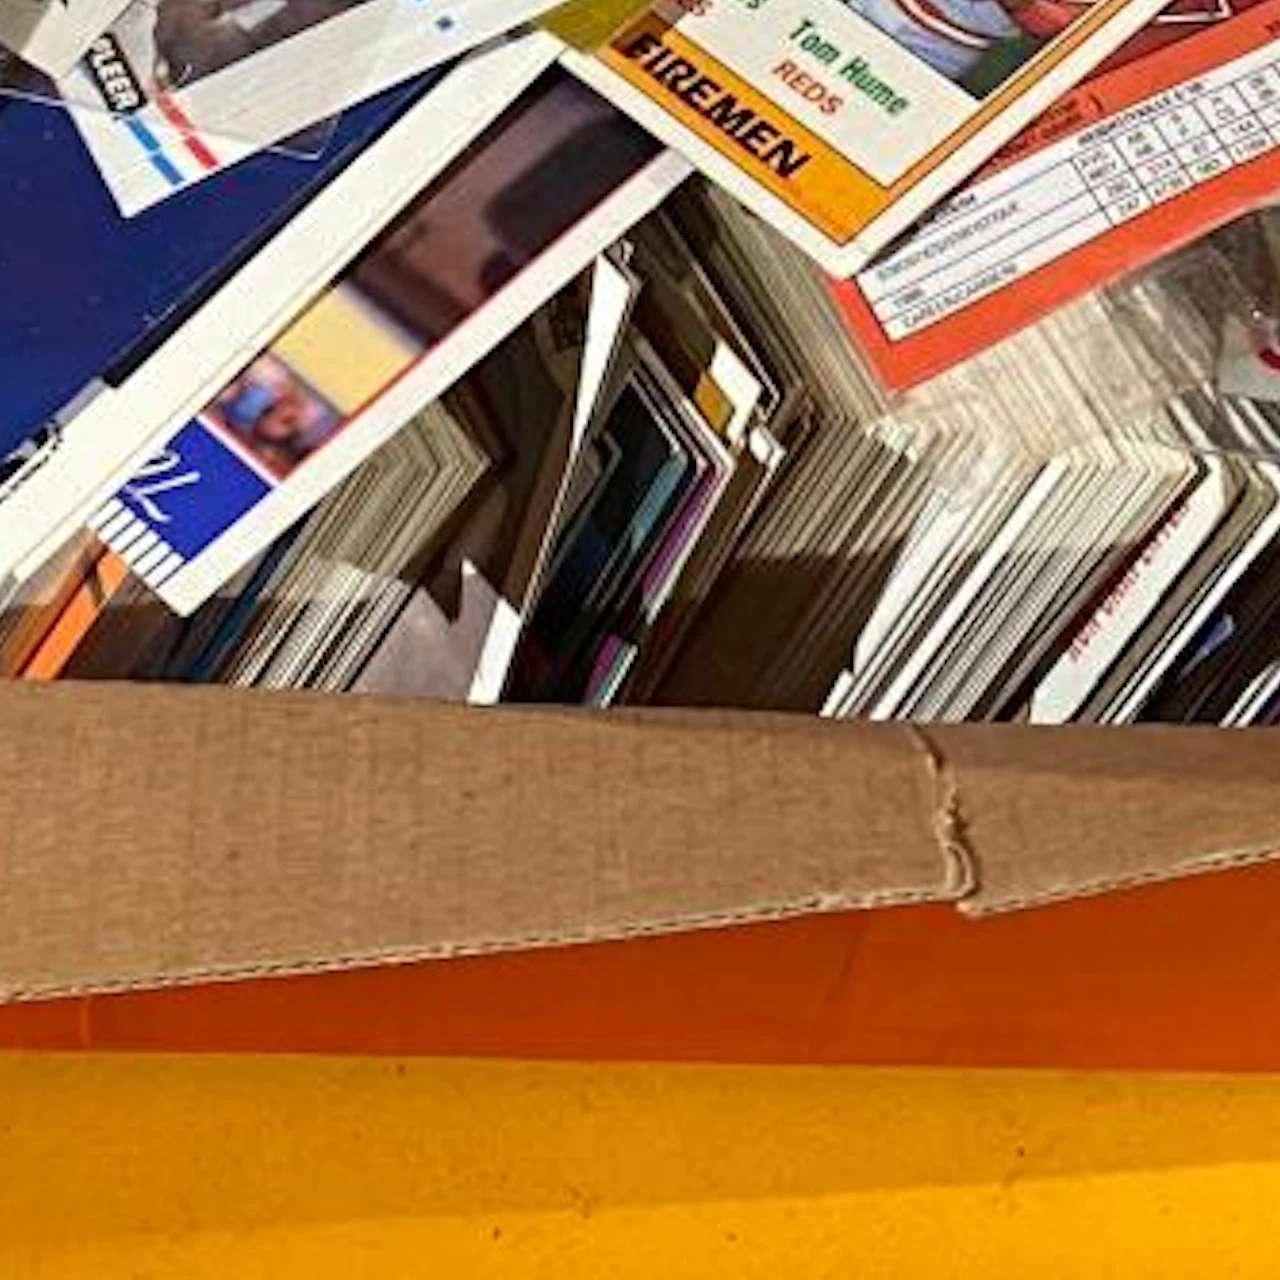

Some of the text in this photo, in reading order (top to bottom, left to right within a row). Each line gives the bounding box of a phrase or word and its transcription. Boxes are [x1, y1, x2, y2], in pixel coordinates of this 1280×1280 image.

[91, 36, 140, 111] FLEER
[623, 30, 813, 179] FIREMEN
[771, 58, 845, 117] REDS
[789, 17, 842, 65] Tom
[839, 56, 911, 117] Hume
